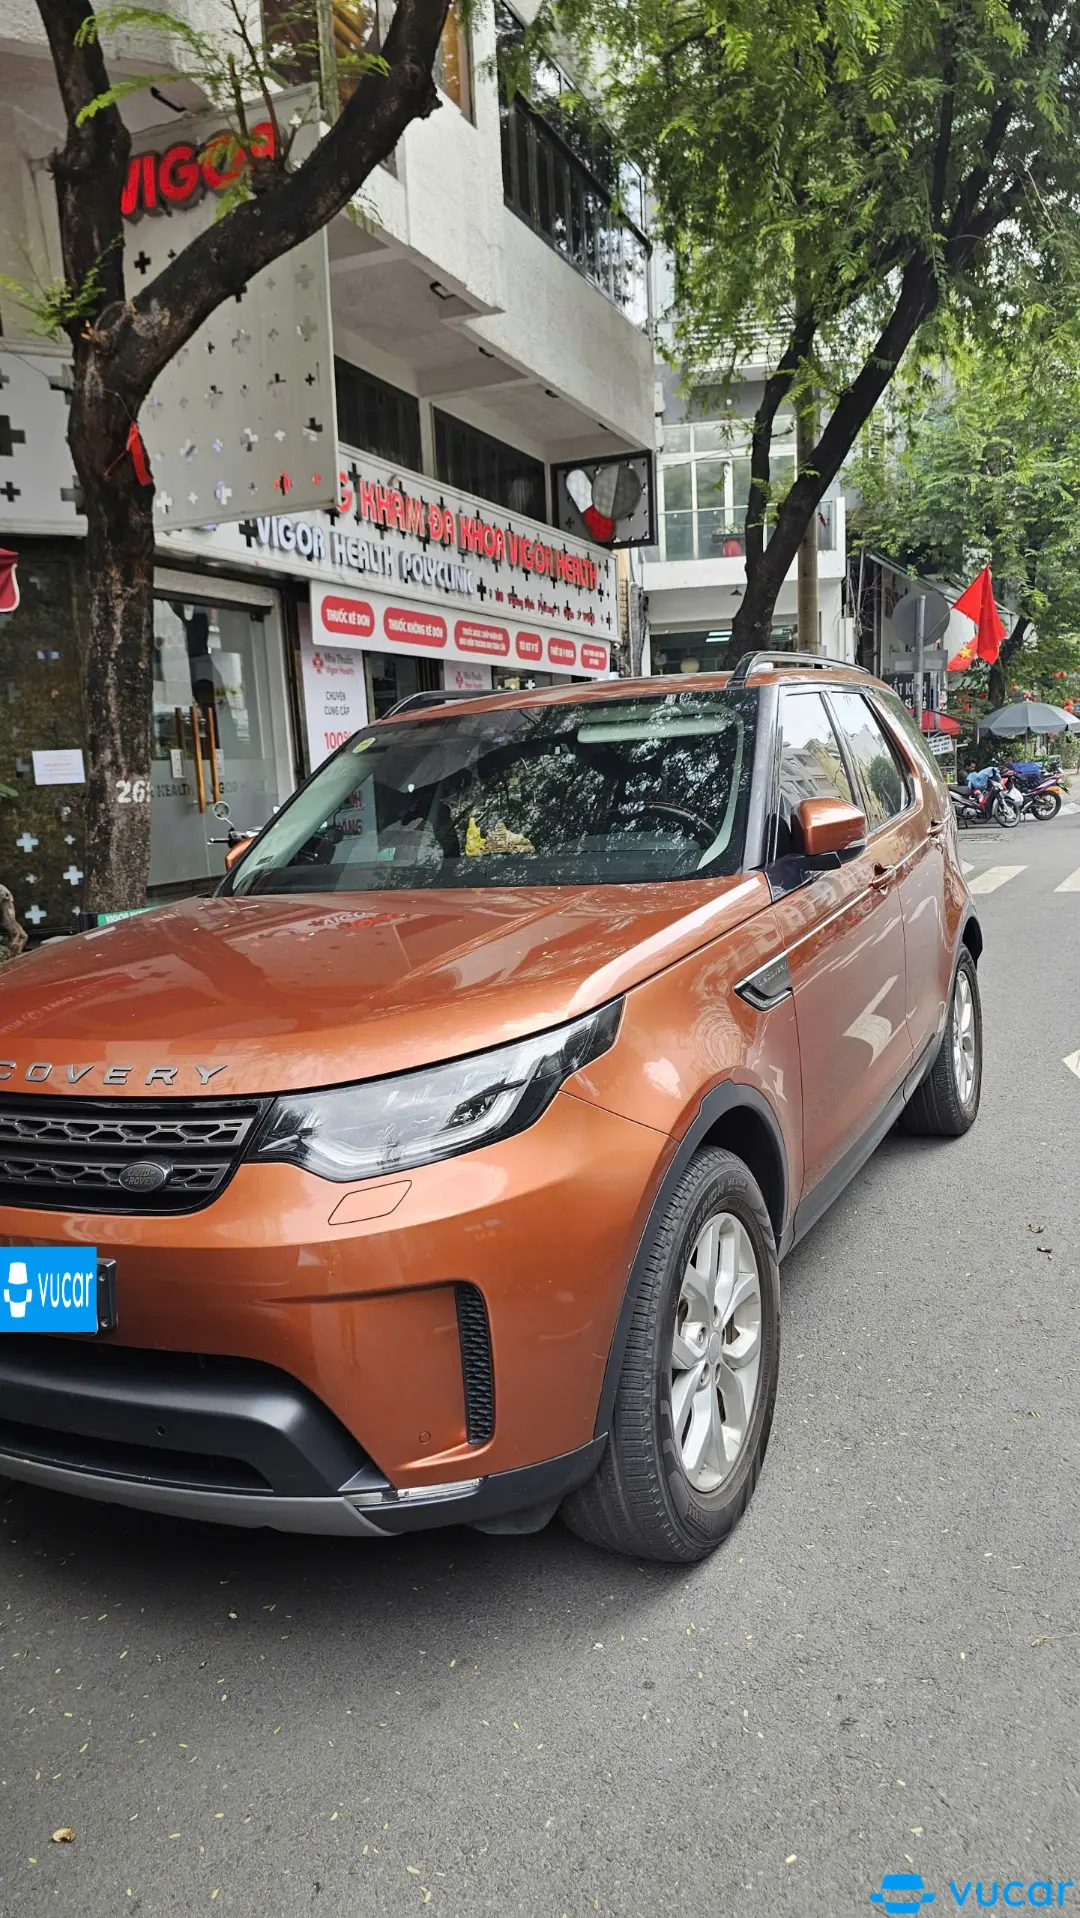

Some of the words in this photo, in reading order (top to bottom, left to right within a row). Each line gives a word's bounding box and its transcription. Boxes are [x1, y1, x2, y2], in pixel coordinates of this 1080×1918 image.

[255, 516, 326, 559] VIGOR
[333, 531, 393, 577] HEALTH
[401, 550, 475, 595] POLYCLINIC
[429, 503, 455, 545] ĐA
[459, 514, 505, 561] KHOA
[507, 531, 554, 574] VIGOR
[555, 550, 598, 590] HEALTH
[905, 679, 927, 695] KÍH
